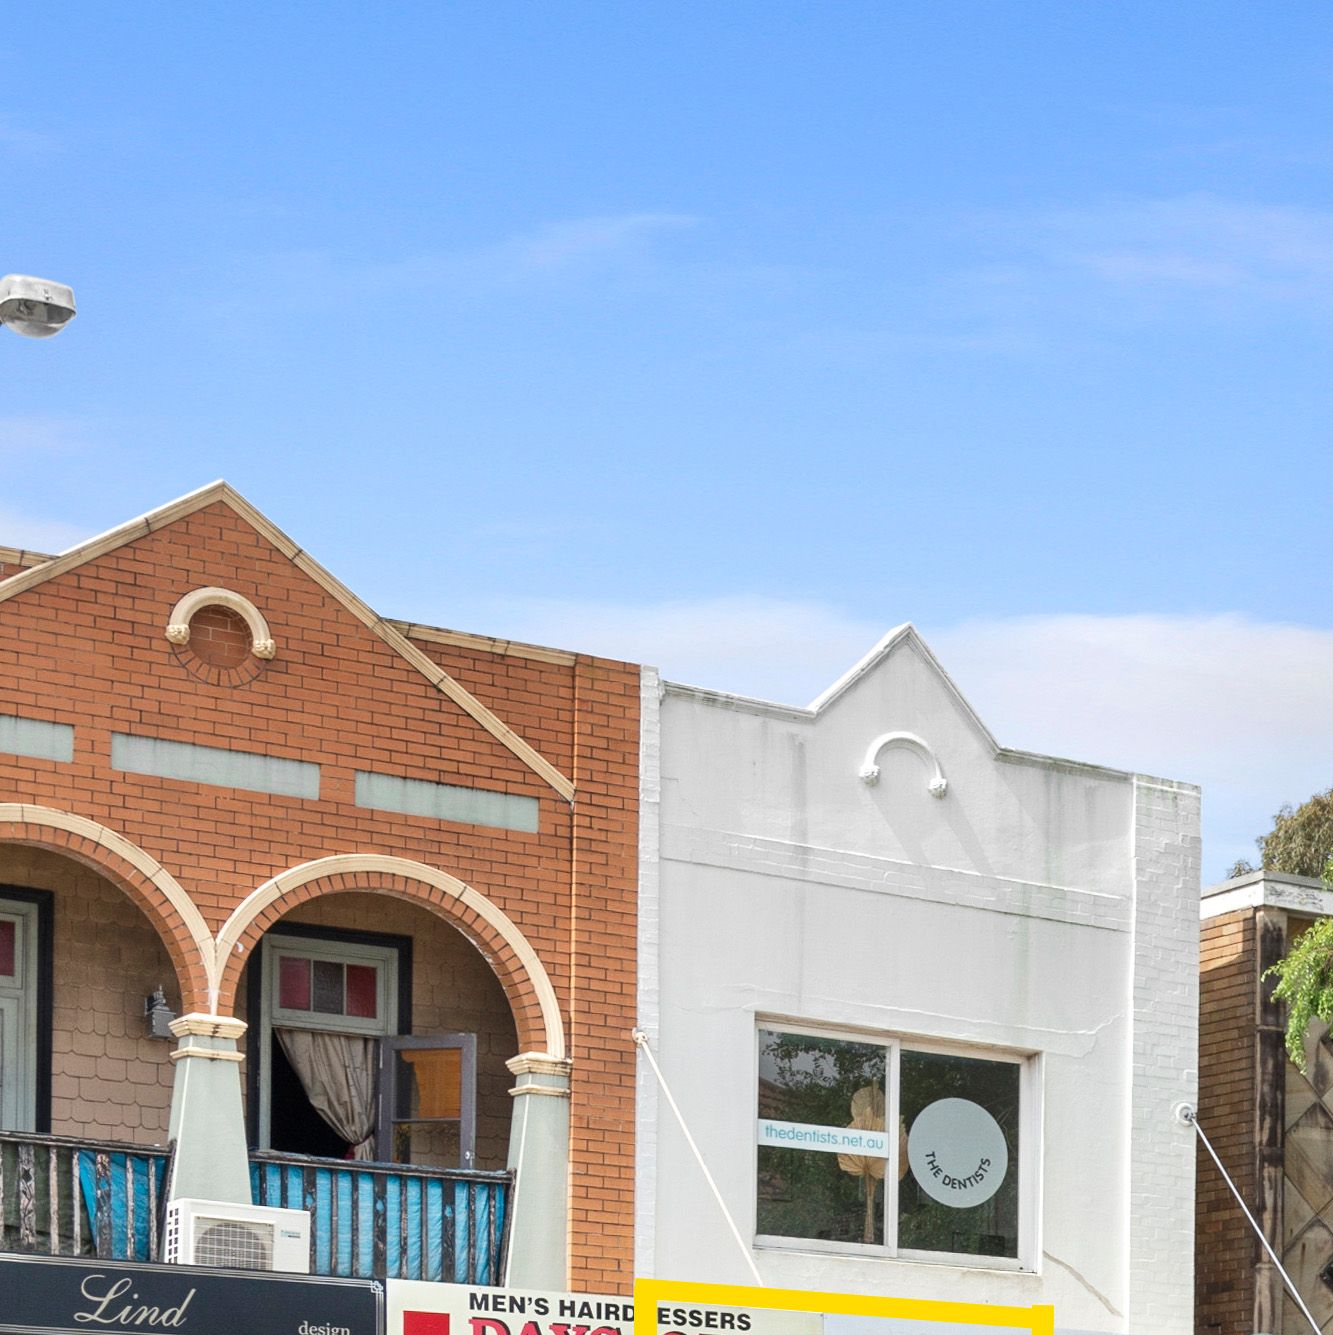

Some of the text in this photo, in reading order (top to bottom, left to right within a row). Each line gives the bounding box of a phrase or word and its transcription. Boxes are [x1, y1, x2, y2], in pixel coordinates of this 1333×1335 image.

[765, 1124, 884, 1150] thedentists.net.au
[925, 1151, 991, 1190] THE DENTISTS
[74, 1274, 196, 1328] Lind
[559, 1299, 753, 1331] HAIRDESSERS
